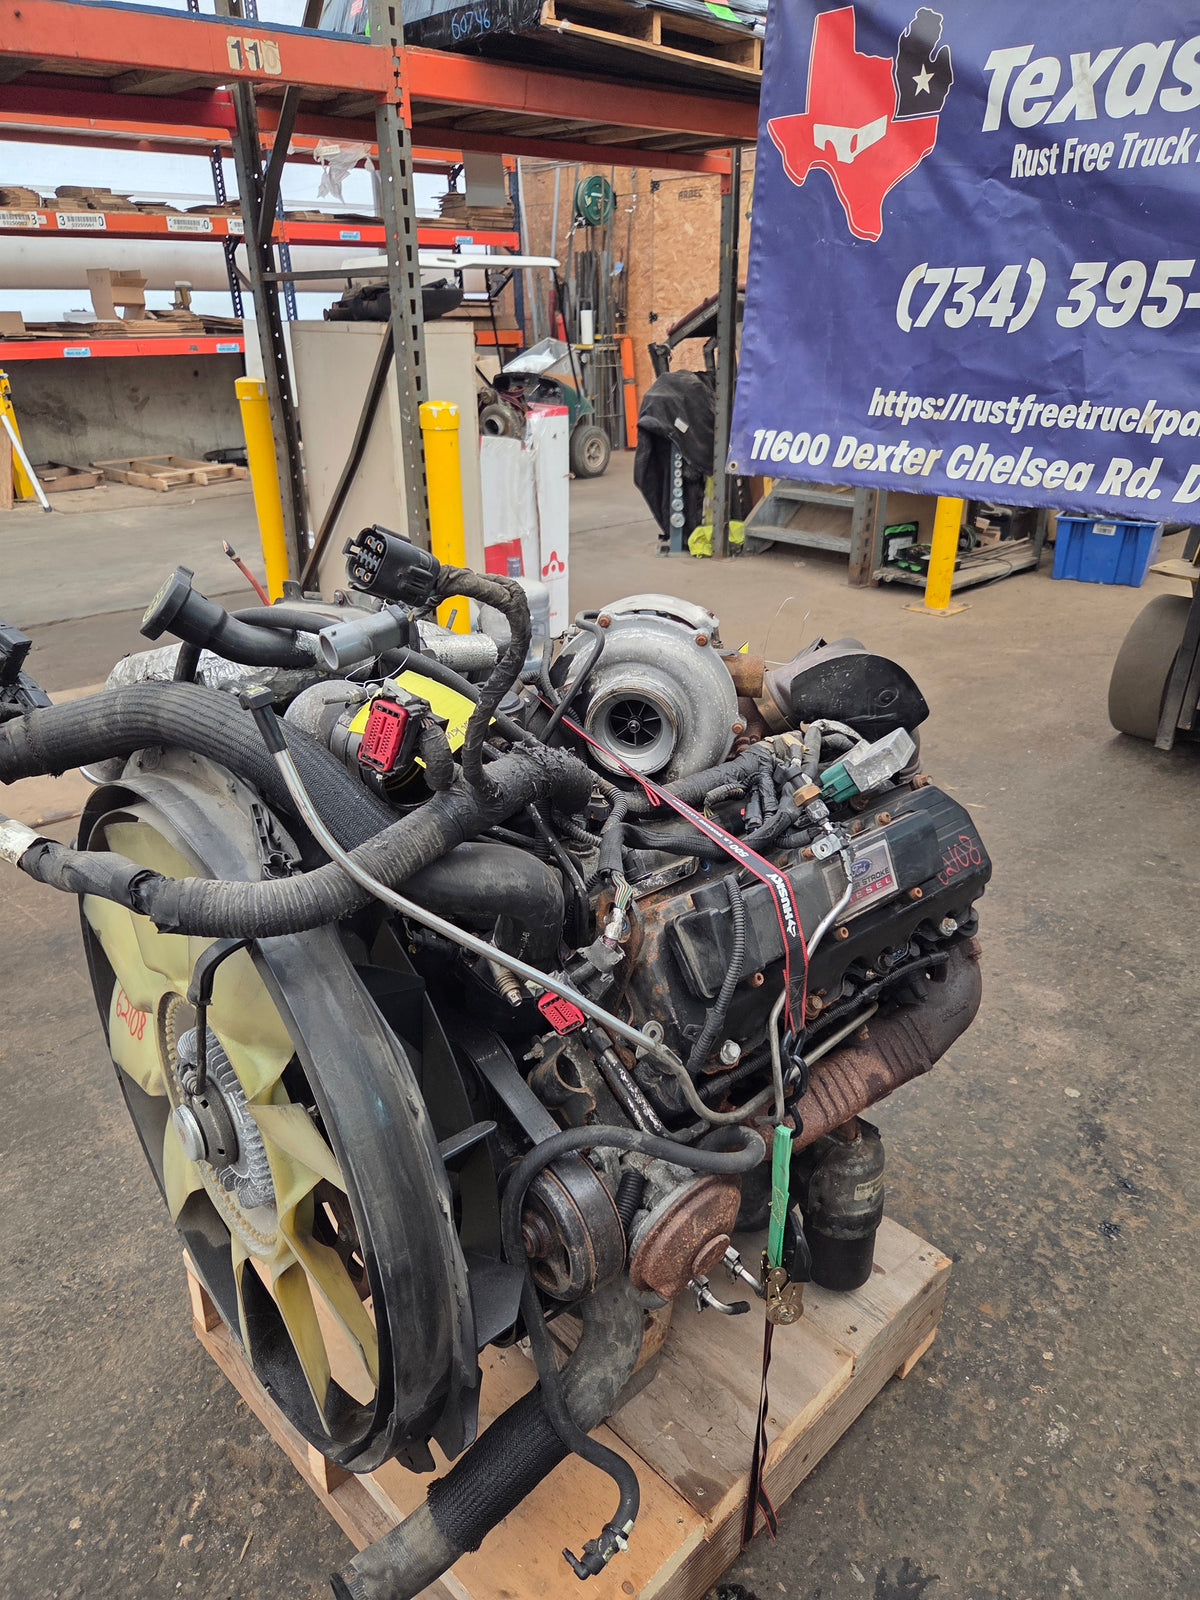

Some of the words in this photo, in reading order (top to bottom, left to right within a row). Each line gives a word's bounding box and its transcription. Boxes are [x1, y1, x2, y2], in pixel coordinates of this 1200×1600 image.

[451, 8, 491, 40] 60746
[982, 35, 1200, 132] Texas
[1010, 143, 1059, 178] Rust
[1061, 138, 1115, 173] Free
[1117, 127, 1199, 169] Truck
[59, 215, 66, 226] 3
[896, 257, 1046, 333] (734)
[868, 387, 1200, 443] https://rustfreetruckpa
[751, 429, 830, 466] 11600
[832, 436, 943, 476] Dexter
[946, 443, 1095, 492] Chelsea
[1096, 457, 1161, 499] Rd.
[729, 844, 749, 858] 500
[766, 873, 794, 921] HUSKY
[850, 877, 891, 902] IESEL
[862, 867, 890, 885] STROKE
[116, 988, 147, 1040] 62108
